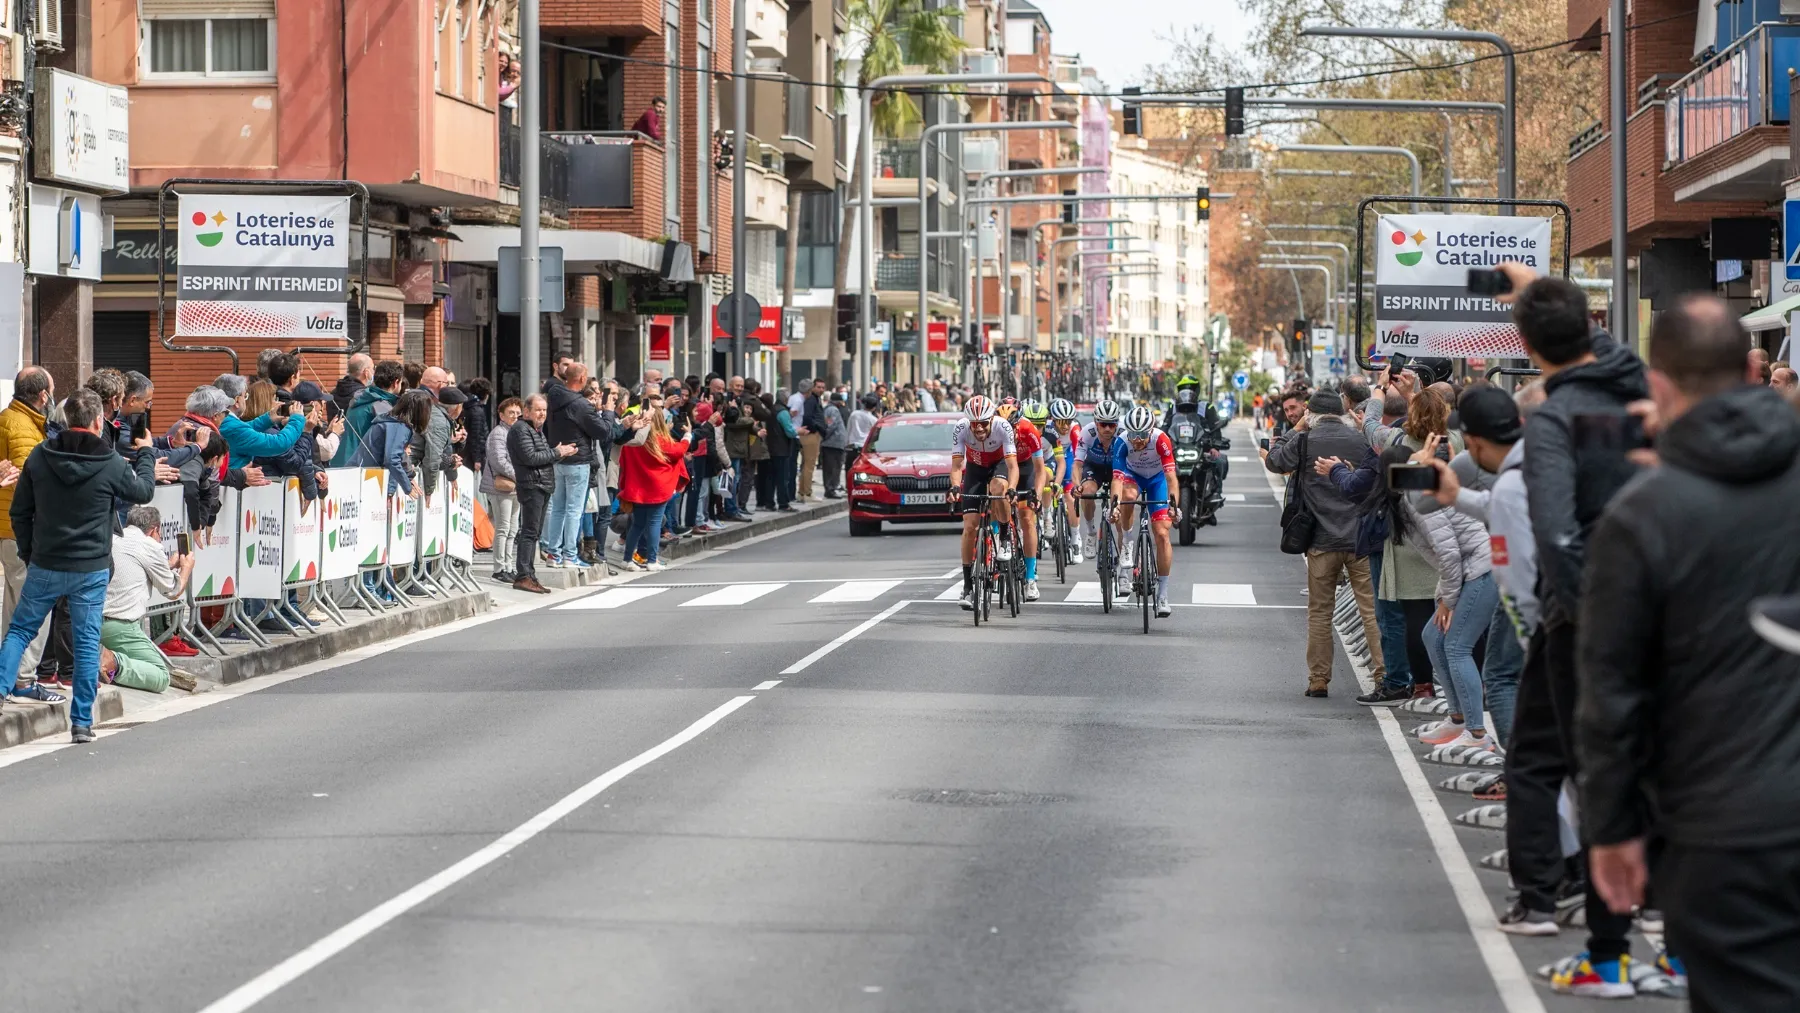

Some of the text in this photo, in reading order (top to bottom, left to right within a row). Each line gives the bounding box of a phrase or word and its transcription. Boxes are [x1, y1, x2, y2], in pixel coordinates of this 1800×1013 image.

[236, 211, 335, 229] Loteries de
[235, 230, 335, 251] Catalunya
[1436, 231, 1537, 249] Loteries de
[1435, 249, 1537, 267] Catalunya
[182, 276, 343, 292] ESPRINT INTERMEDI
[1782, 280, 1800, 294] Ca
[1382, 296, 1450, 311] ESPRINT
[306, 315, 344, 331] Volta
[1381, 330, 1419, 345] Volta
[906, 494, 927, 504] 3370
[160, 513, 179, 541] oteries
[258, 509, 276, 536] Loteries
